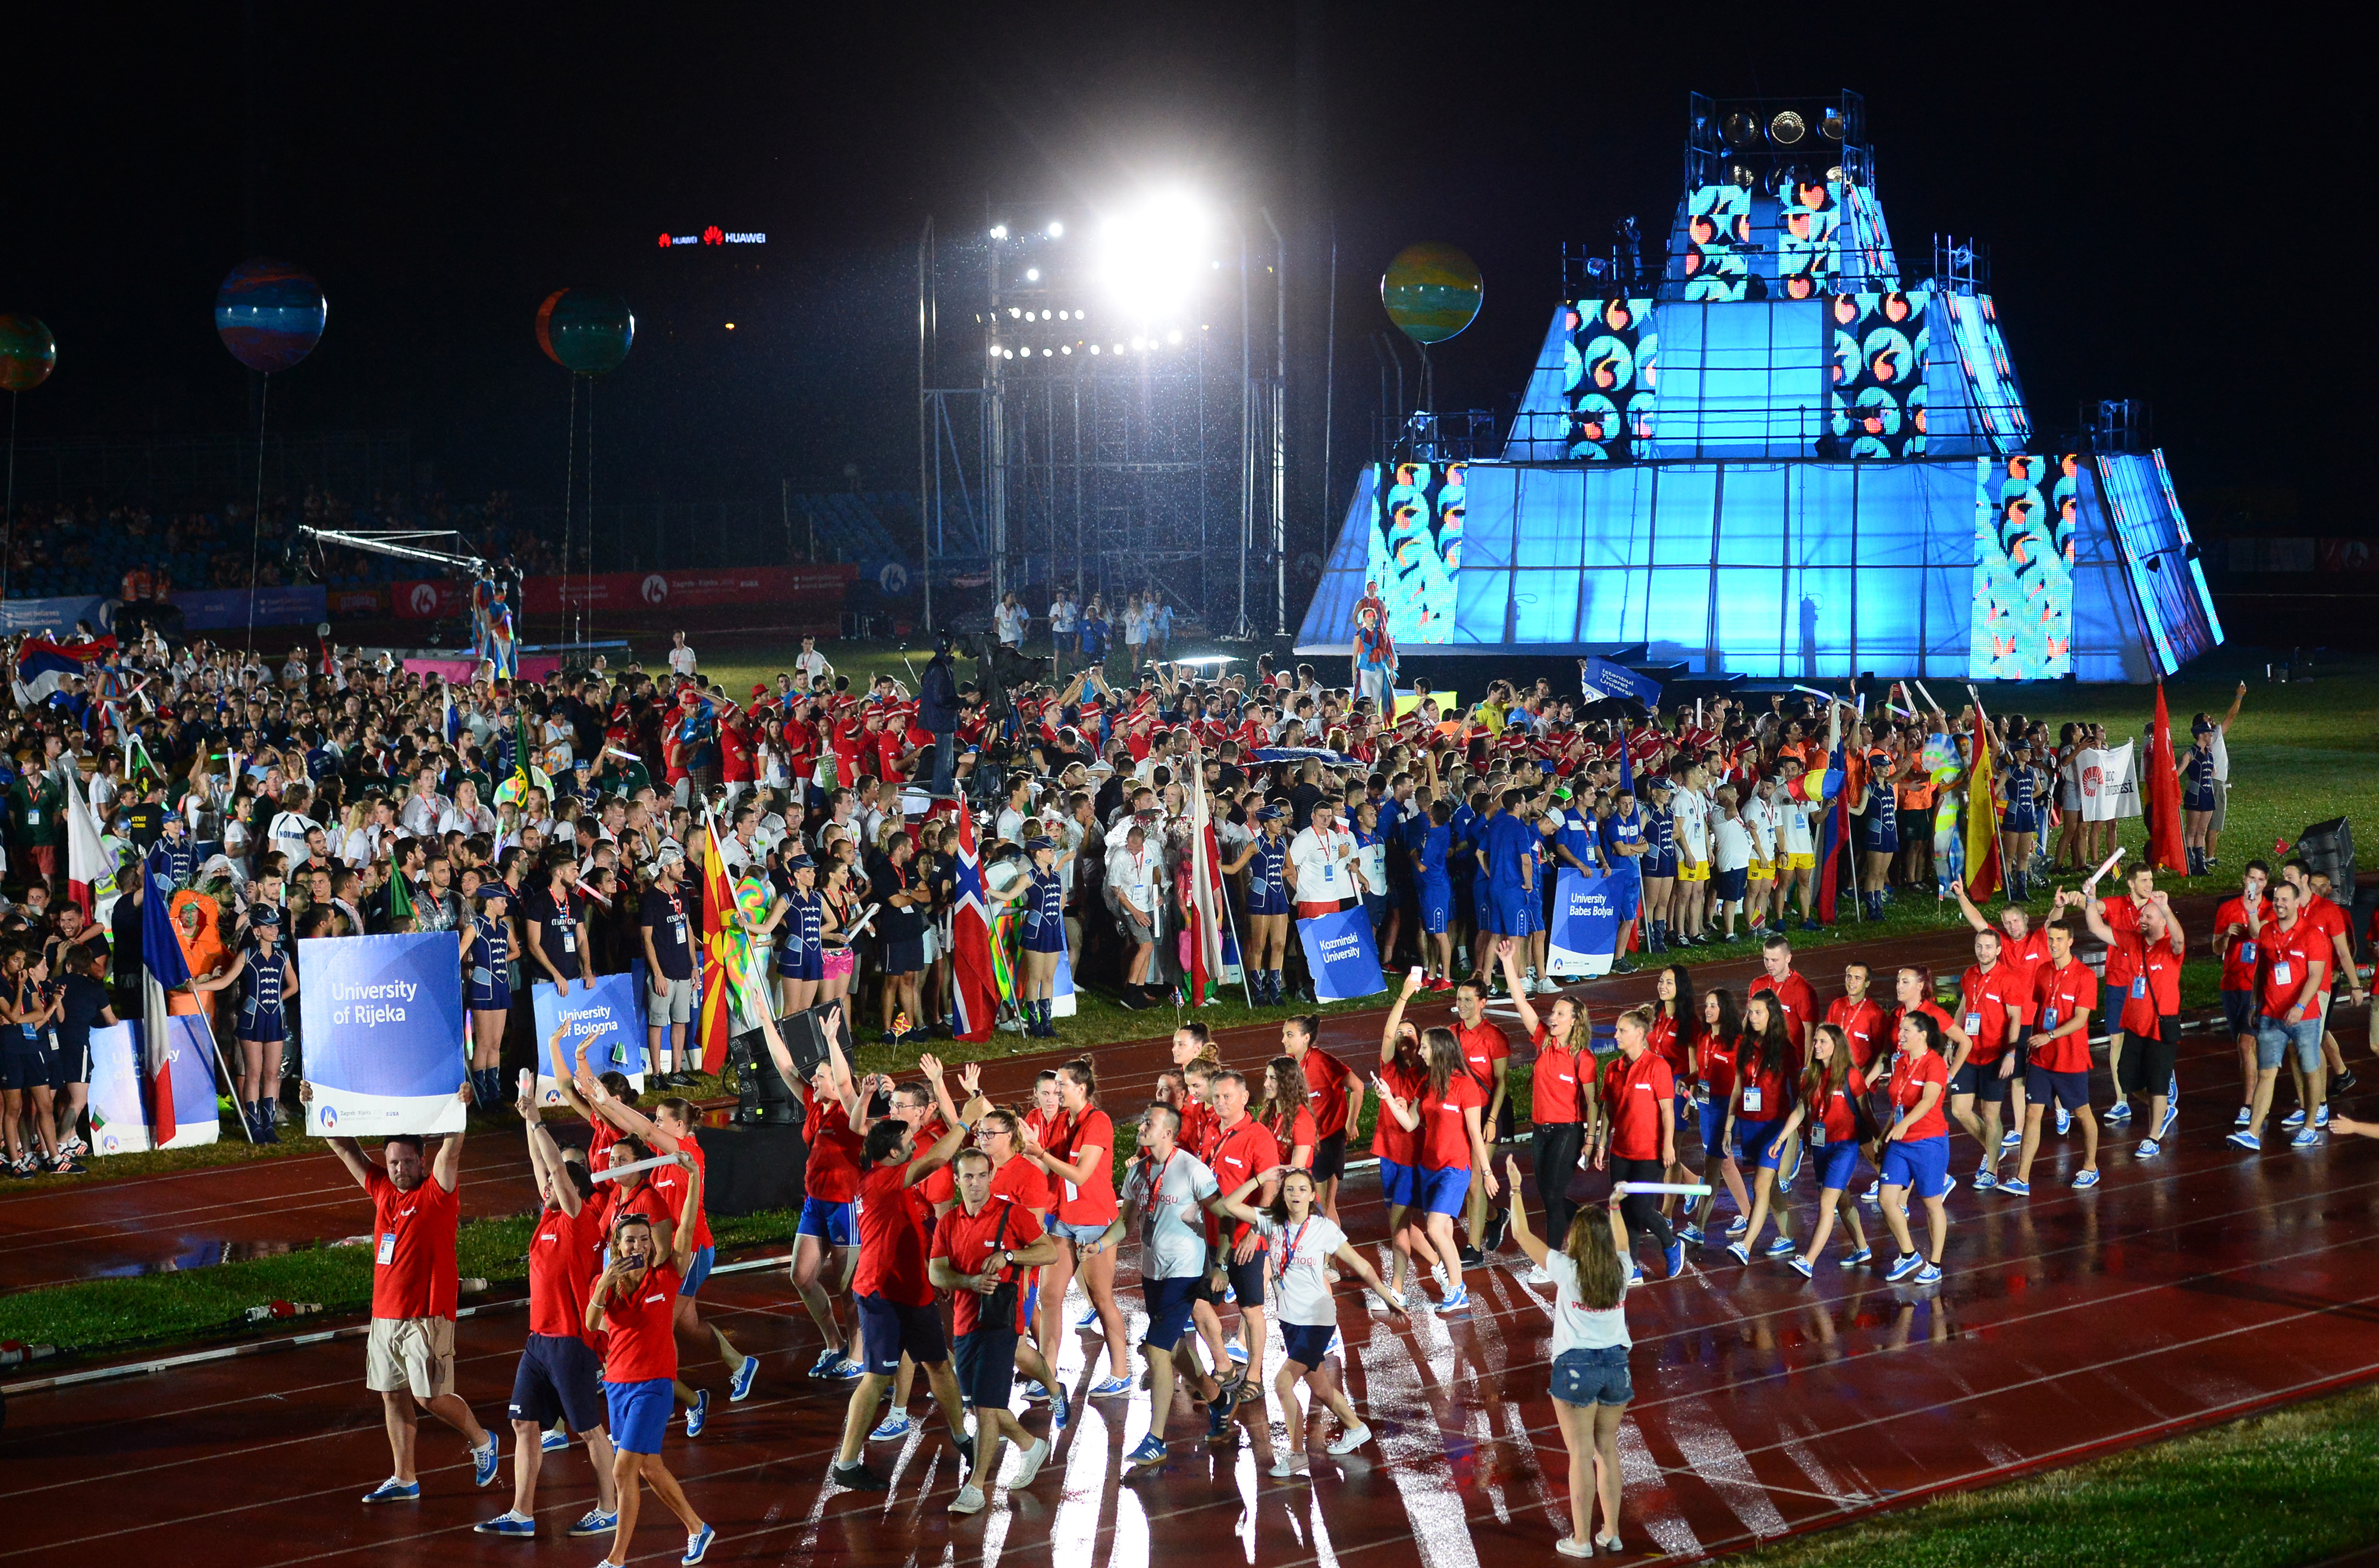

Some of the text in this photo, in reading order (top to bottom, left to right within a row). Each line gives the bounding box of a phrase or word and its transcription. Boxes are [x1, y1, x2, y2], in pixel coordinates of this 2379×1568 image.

[672, 236, 698, 244] HUAWEI
[725, 232, 766, 243] HUAWEI
[1601, 673, 1628, 689] Ticaret
[1602, 668, 1634, 686] Istanbul
[1600, 678, 1634, 697] Universit
[823, 761, 833, 777] LOVE
[1571, 893, 1607, 906] University
[1570, 906, 1614, 919] Babes Bolyai
[1319, 932, 1358, 951] Kozminski
[1323, 947, 1360, 963] University
[332, 980, 418, 1003] University
[333, 1004, 406, 1028] of Rijeka
[558, 1005, 611, 1022] University
[574, 1020, 618, 1037] Bologna
[1293, 1256, 1317, 1267] mogu
